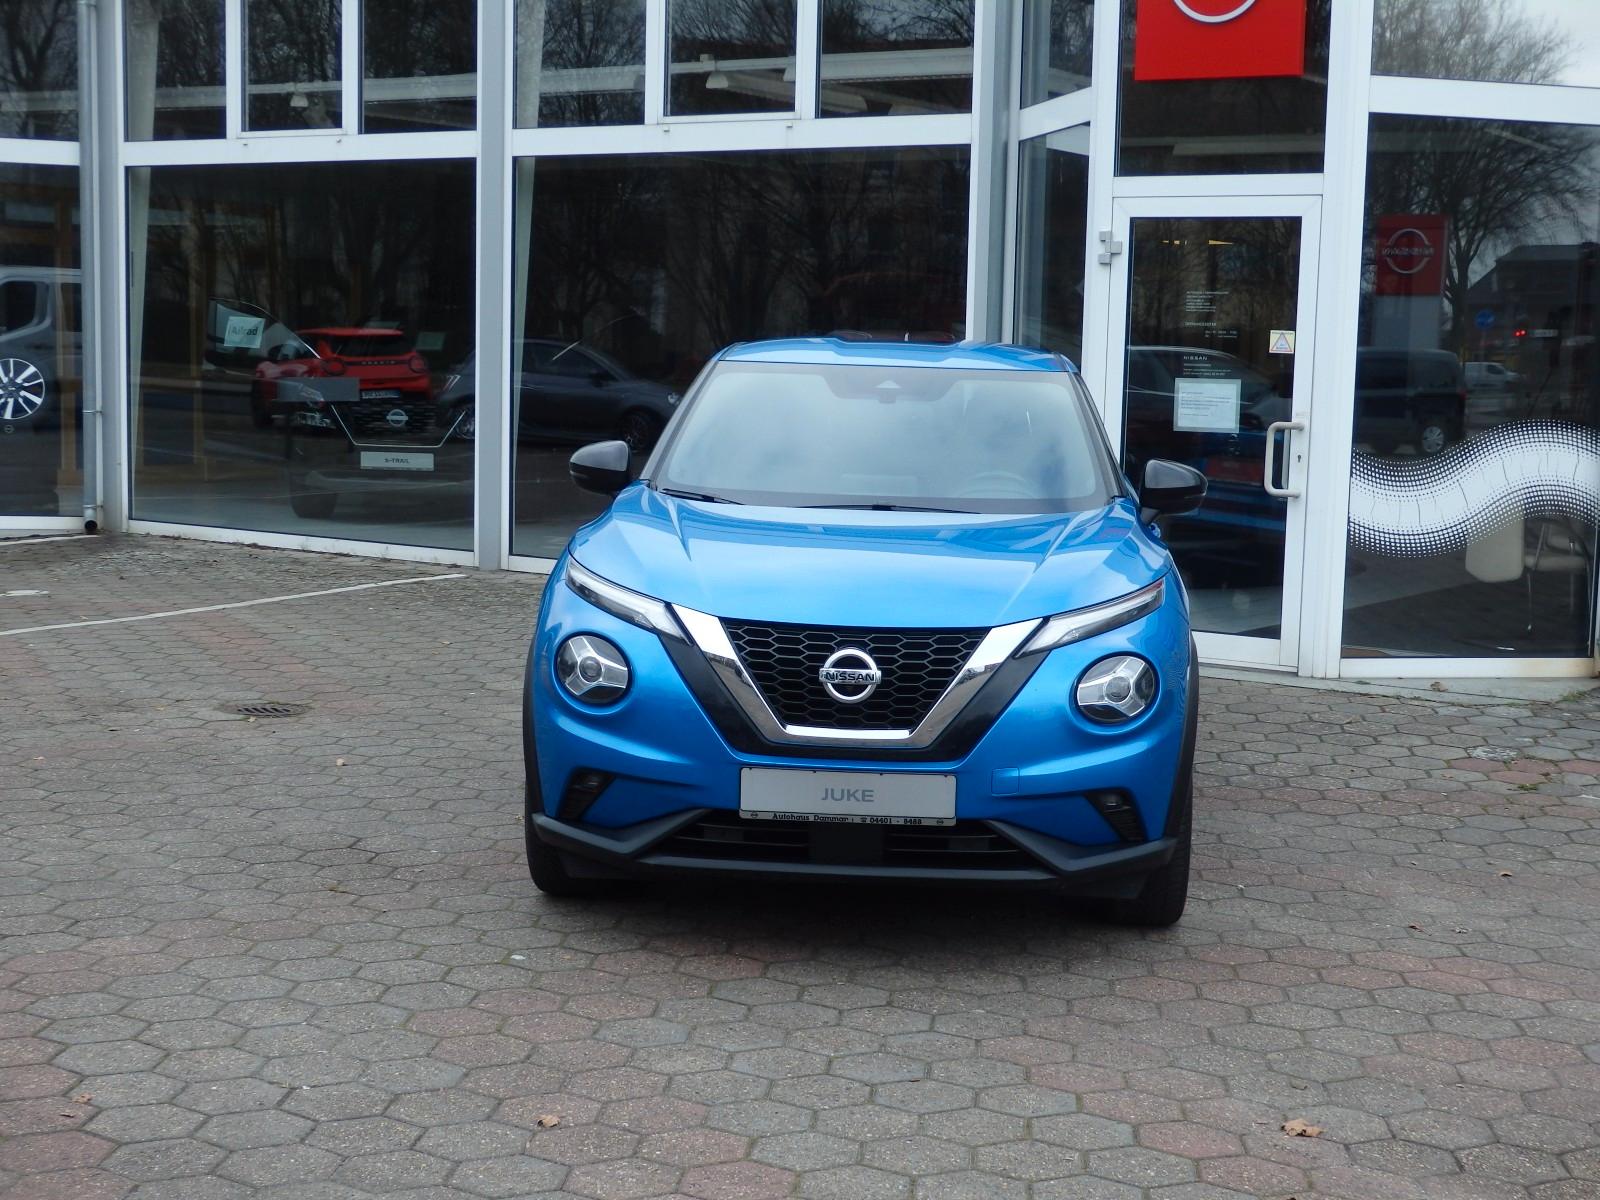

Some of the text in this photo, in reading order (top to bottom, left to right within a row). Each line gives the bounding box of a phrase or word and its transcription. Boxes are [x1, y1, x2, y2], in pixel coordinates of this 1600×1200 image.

[825, 671, 875, 682] NISSAN
[820, 787, 875, 803] JUKE
[772, 812, 810, 821] Autohaus
